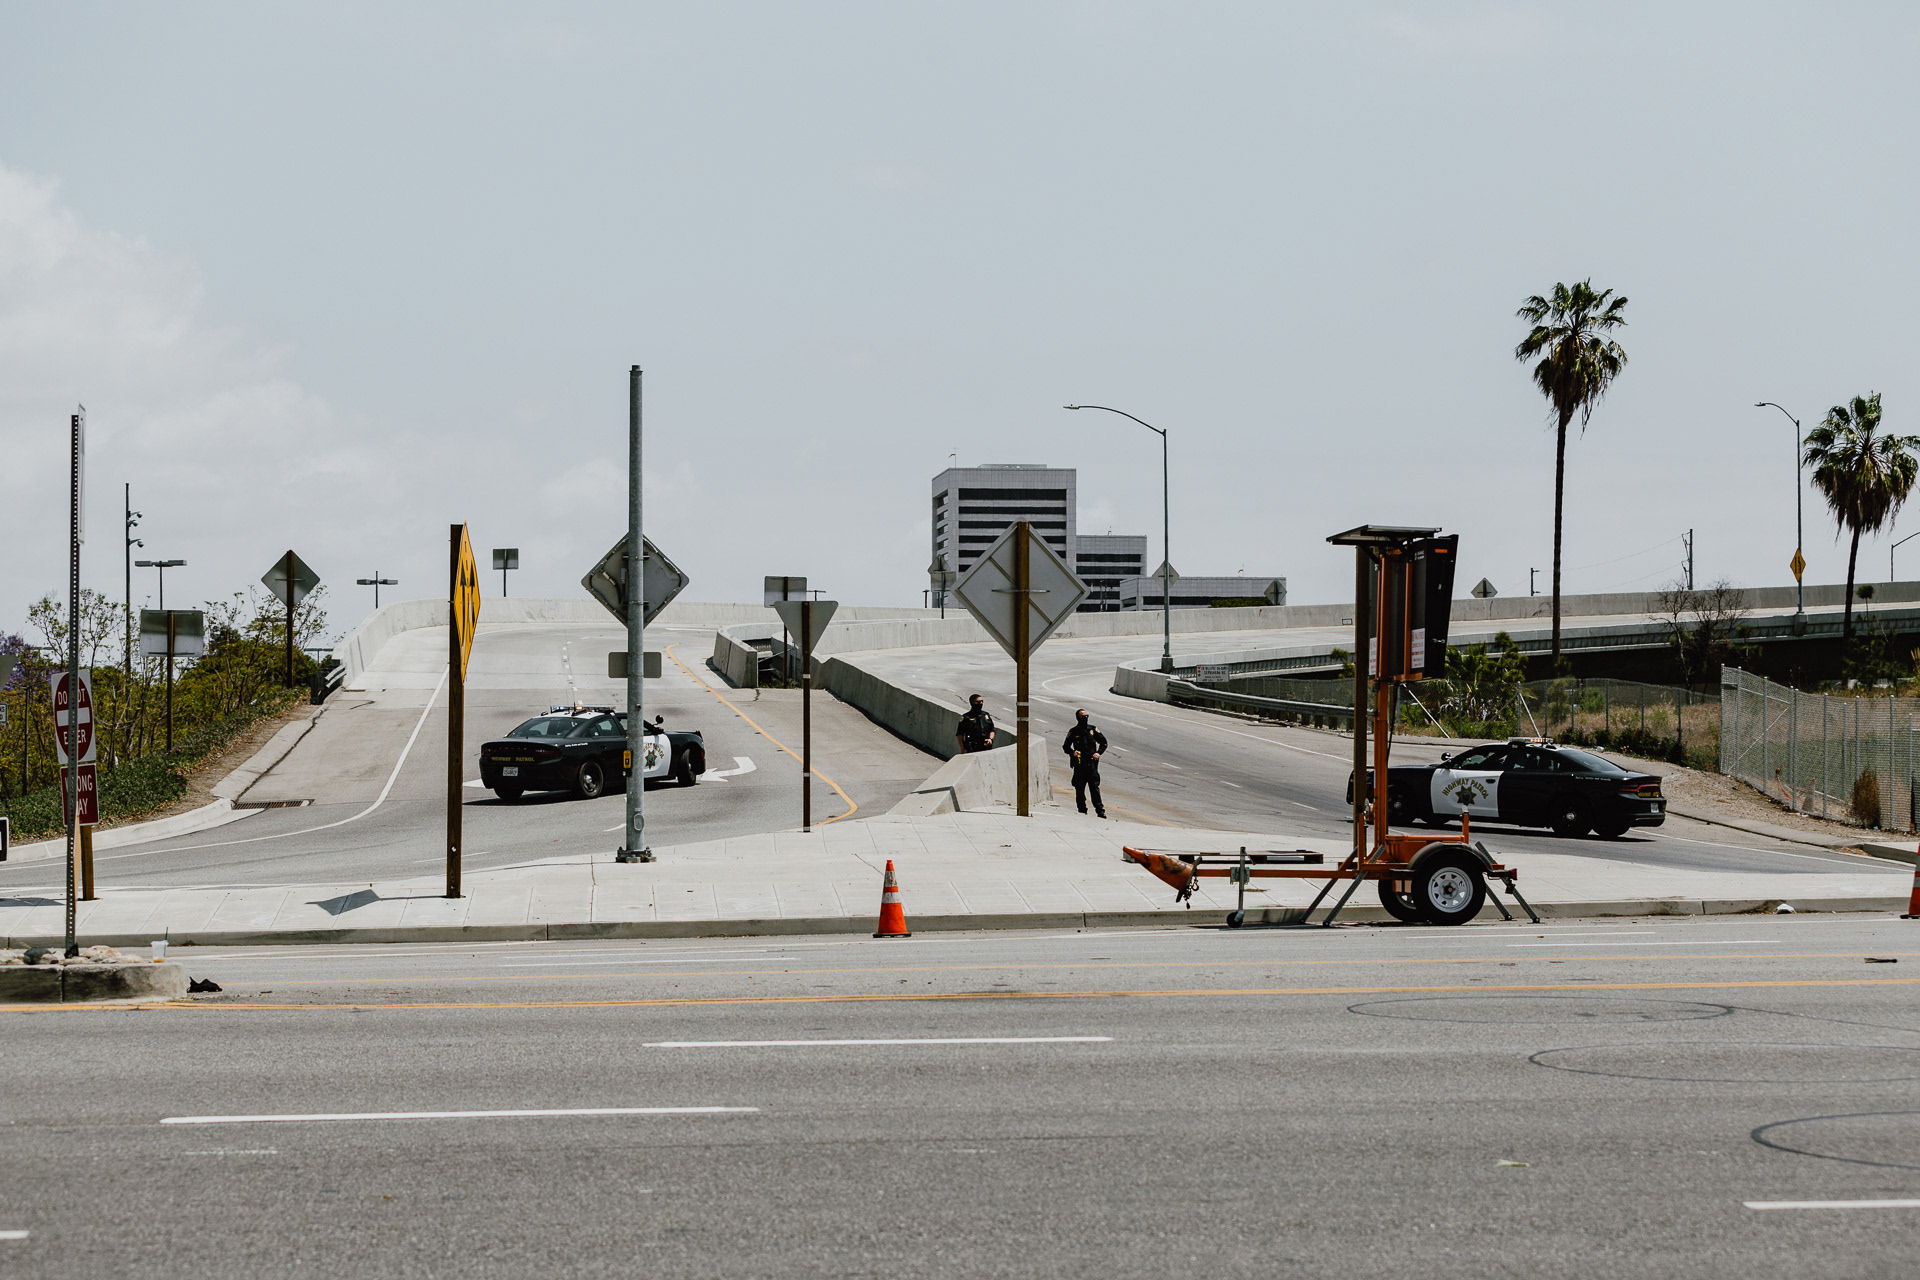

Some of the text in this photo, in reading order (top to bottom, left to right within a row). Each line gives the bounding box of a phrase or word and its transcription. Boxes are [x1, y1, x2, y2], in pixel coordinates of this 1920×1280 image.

[58, 690, 68, 705] DO
[64, 729, 86, 745] EER
[1442, 778, 1488, 799] HIGHWAY PATROL
